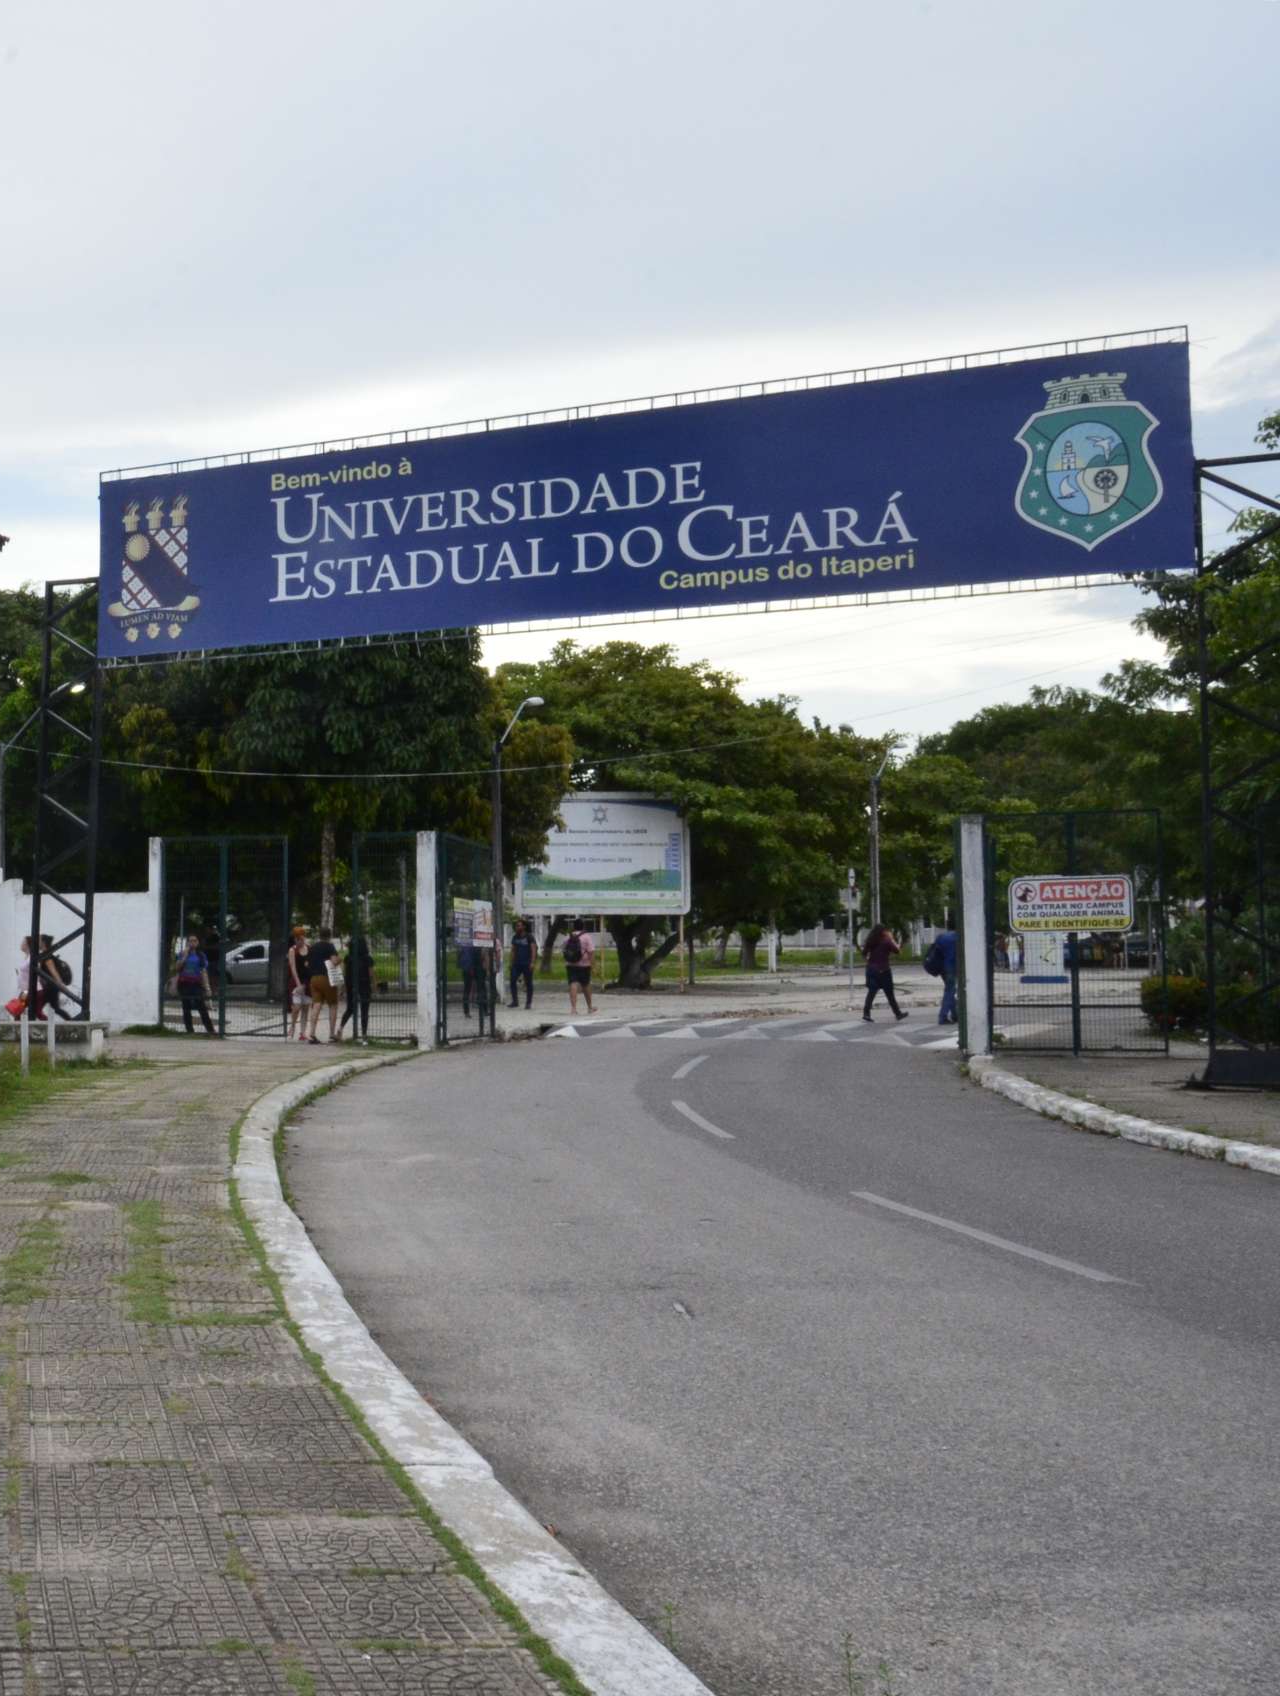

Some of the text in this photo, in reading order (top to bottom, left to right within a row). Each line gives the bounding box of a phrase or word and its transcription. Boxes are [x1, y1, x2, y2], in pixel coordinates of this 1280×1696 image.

[271, 457, 412, 491] Bem-vindo à
[270, 462, 706, 544] UNIVERSIDADE
[269, 491, 919, 602] ESTADUAL DO CEARÁ
[659, 549, 915, 590] Campus do Itaperi
[1041, 882, 1124, 900] ATENÇÃO
[1086, 902, 1125, 910] CAMPUS
[1091, 909, 1126, 917] ANIMAL
[1018, 918, 1125, 929] PARE E IDENTIFIQUE-SE
